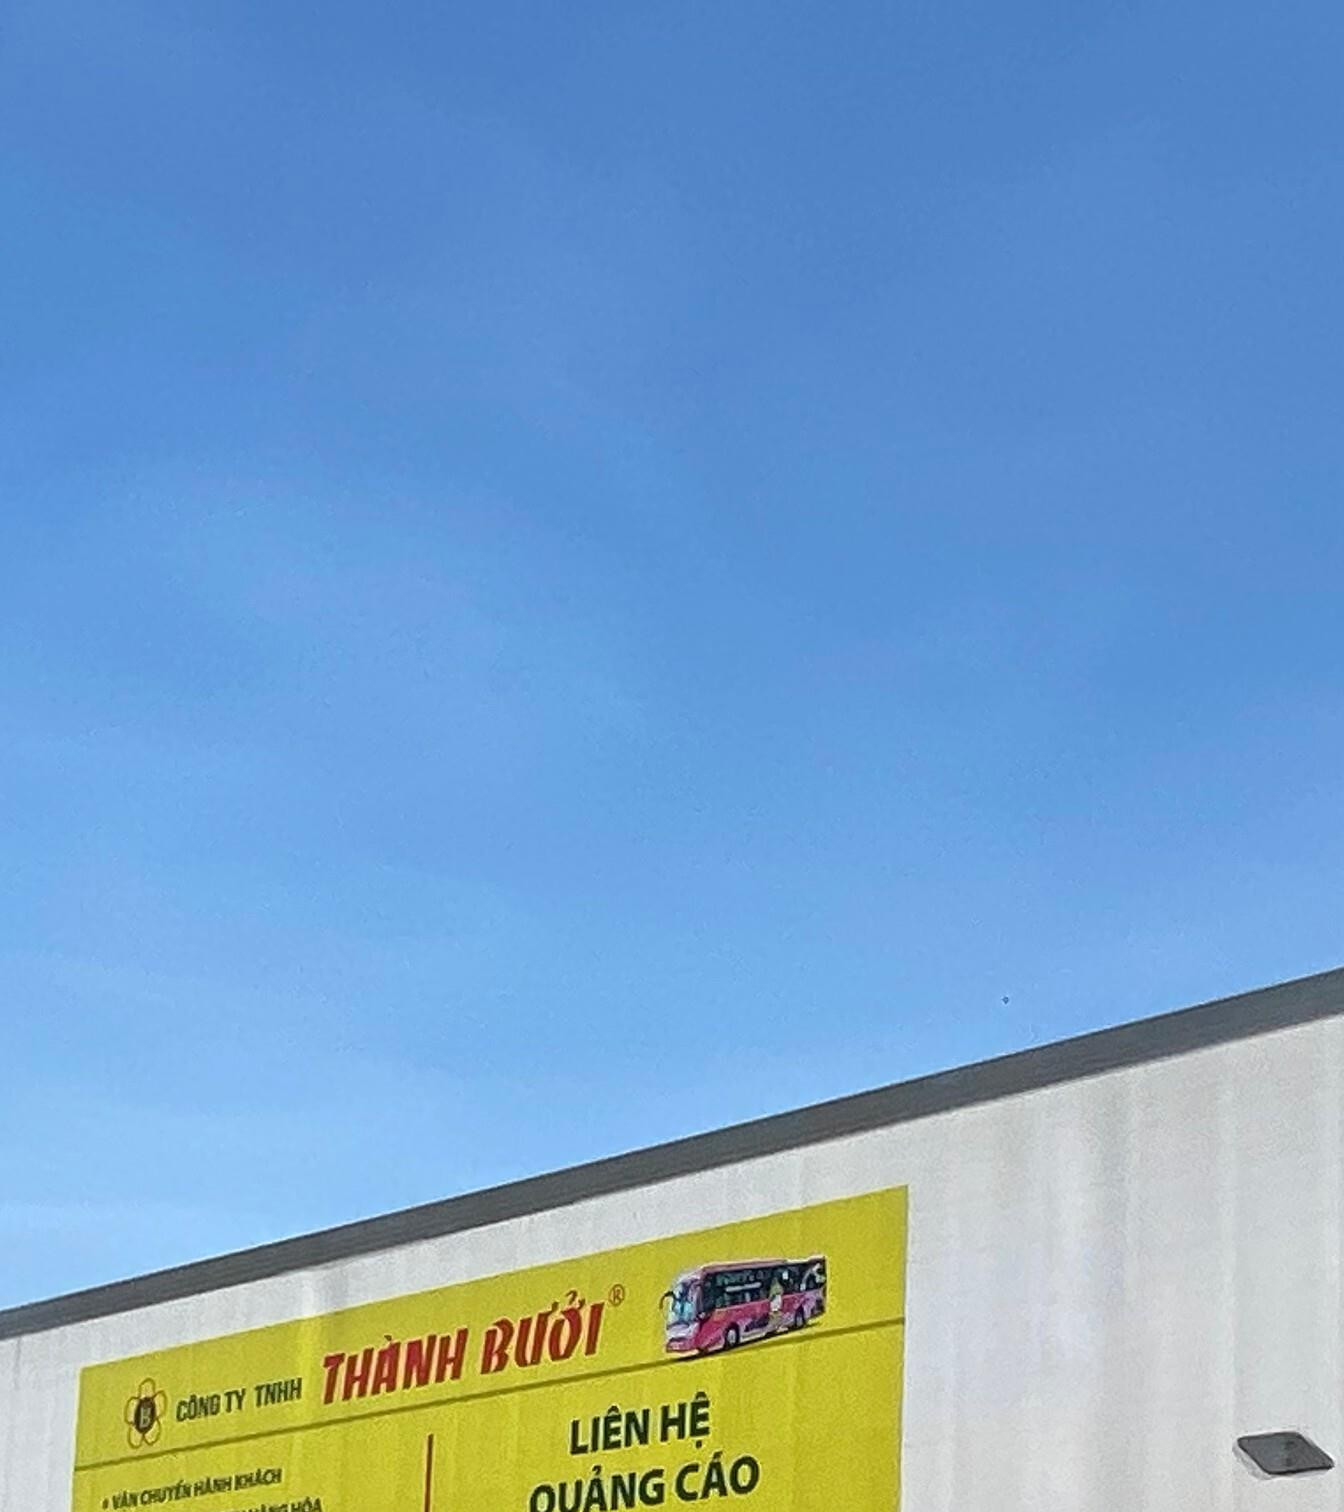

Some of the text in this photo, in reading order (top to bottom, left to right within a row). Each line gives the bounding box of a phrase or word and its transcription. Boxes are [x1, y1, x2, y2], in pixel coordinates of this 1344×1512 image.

[323, 1328, 468, 1405] THÀNH
[480, 1290, 605, 1374] BƯỞI
[176, 1377, 302, 1422] CÔNG TY TNHH
[570, 1391, 711, 1455] LIÊN HỆ
[675, 1451, 759, 1502] CÁO
